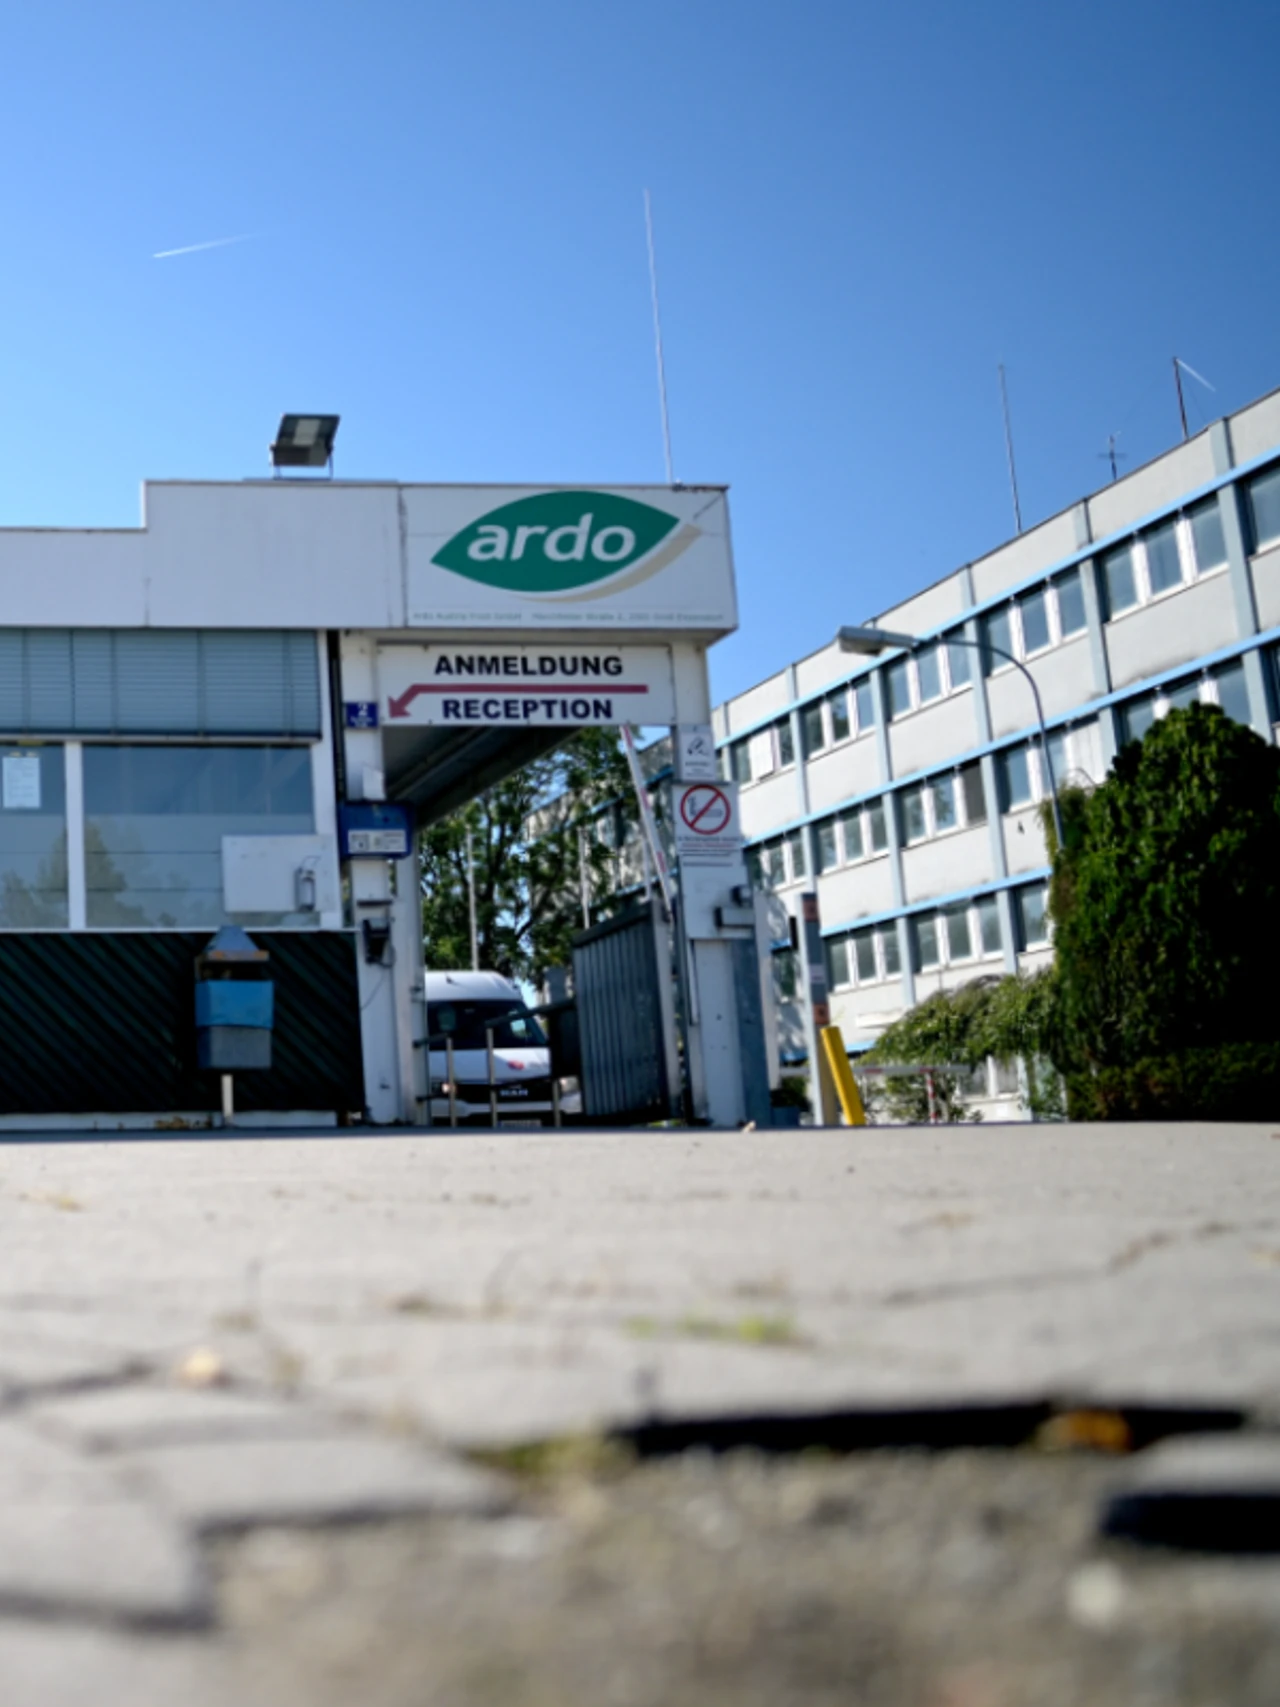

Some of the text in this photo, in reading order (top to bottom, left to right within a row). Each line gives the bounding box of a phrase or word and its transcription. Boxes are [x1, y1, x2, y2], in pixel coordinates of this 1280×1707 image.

[467, 512, 636, 562] ardo
[435, 655, 623, 676] ANMELDUNG
[442, 699, 613, 719] RECEPTION
